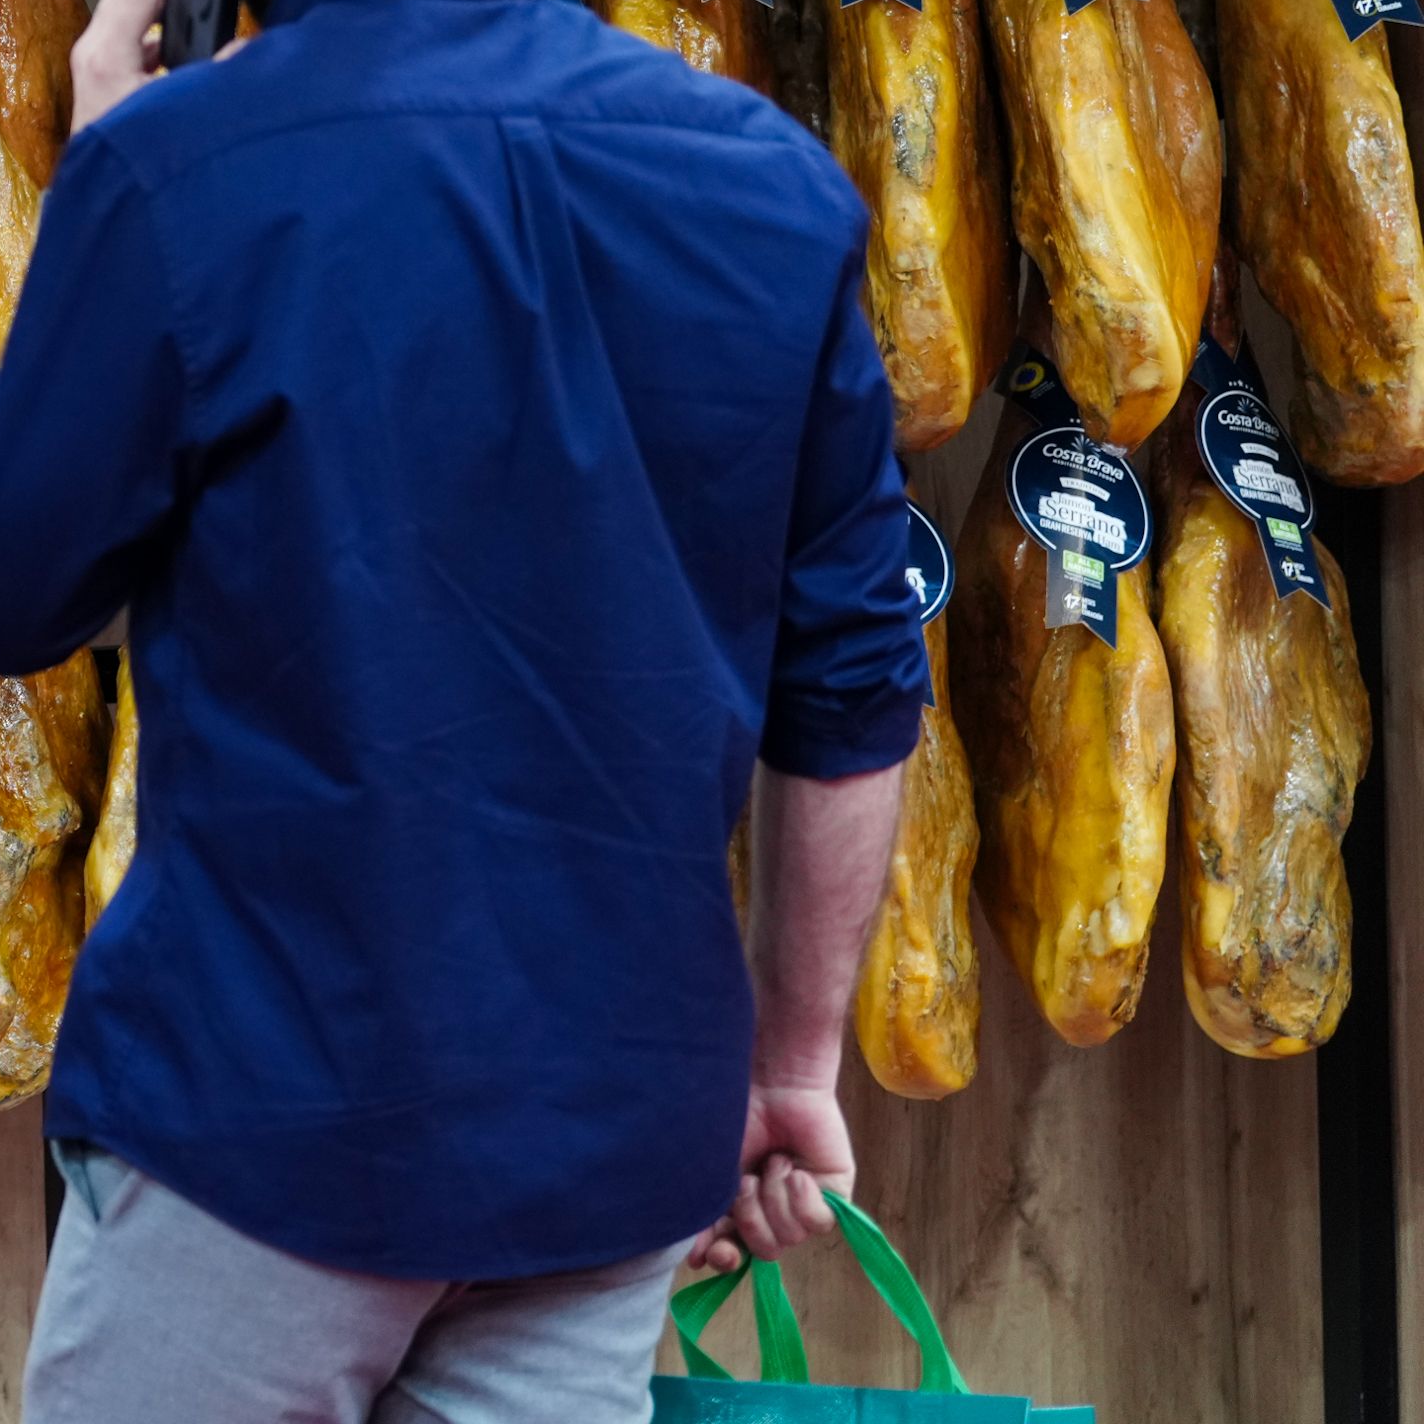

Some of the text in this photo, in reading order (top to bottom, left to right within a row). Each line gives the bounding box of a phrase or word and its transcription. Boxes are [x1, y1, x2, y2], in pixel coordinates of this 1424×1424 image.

[1044, 440, 1126, 482] Costa Brava
[1046, 498, 1121, 538] Serrano
